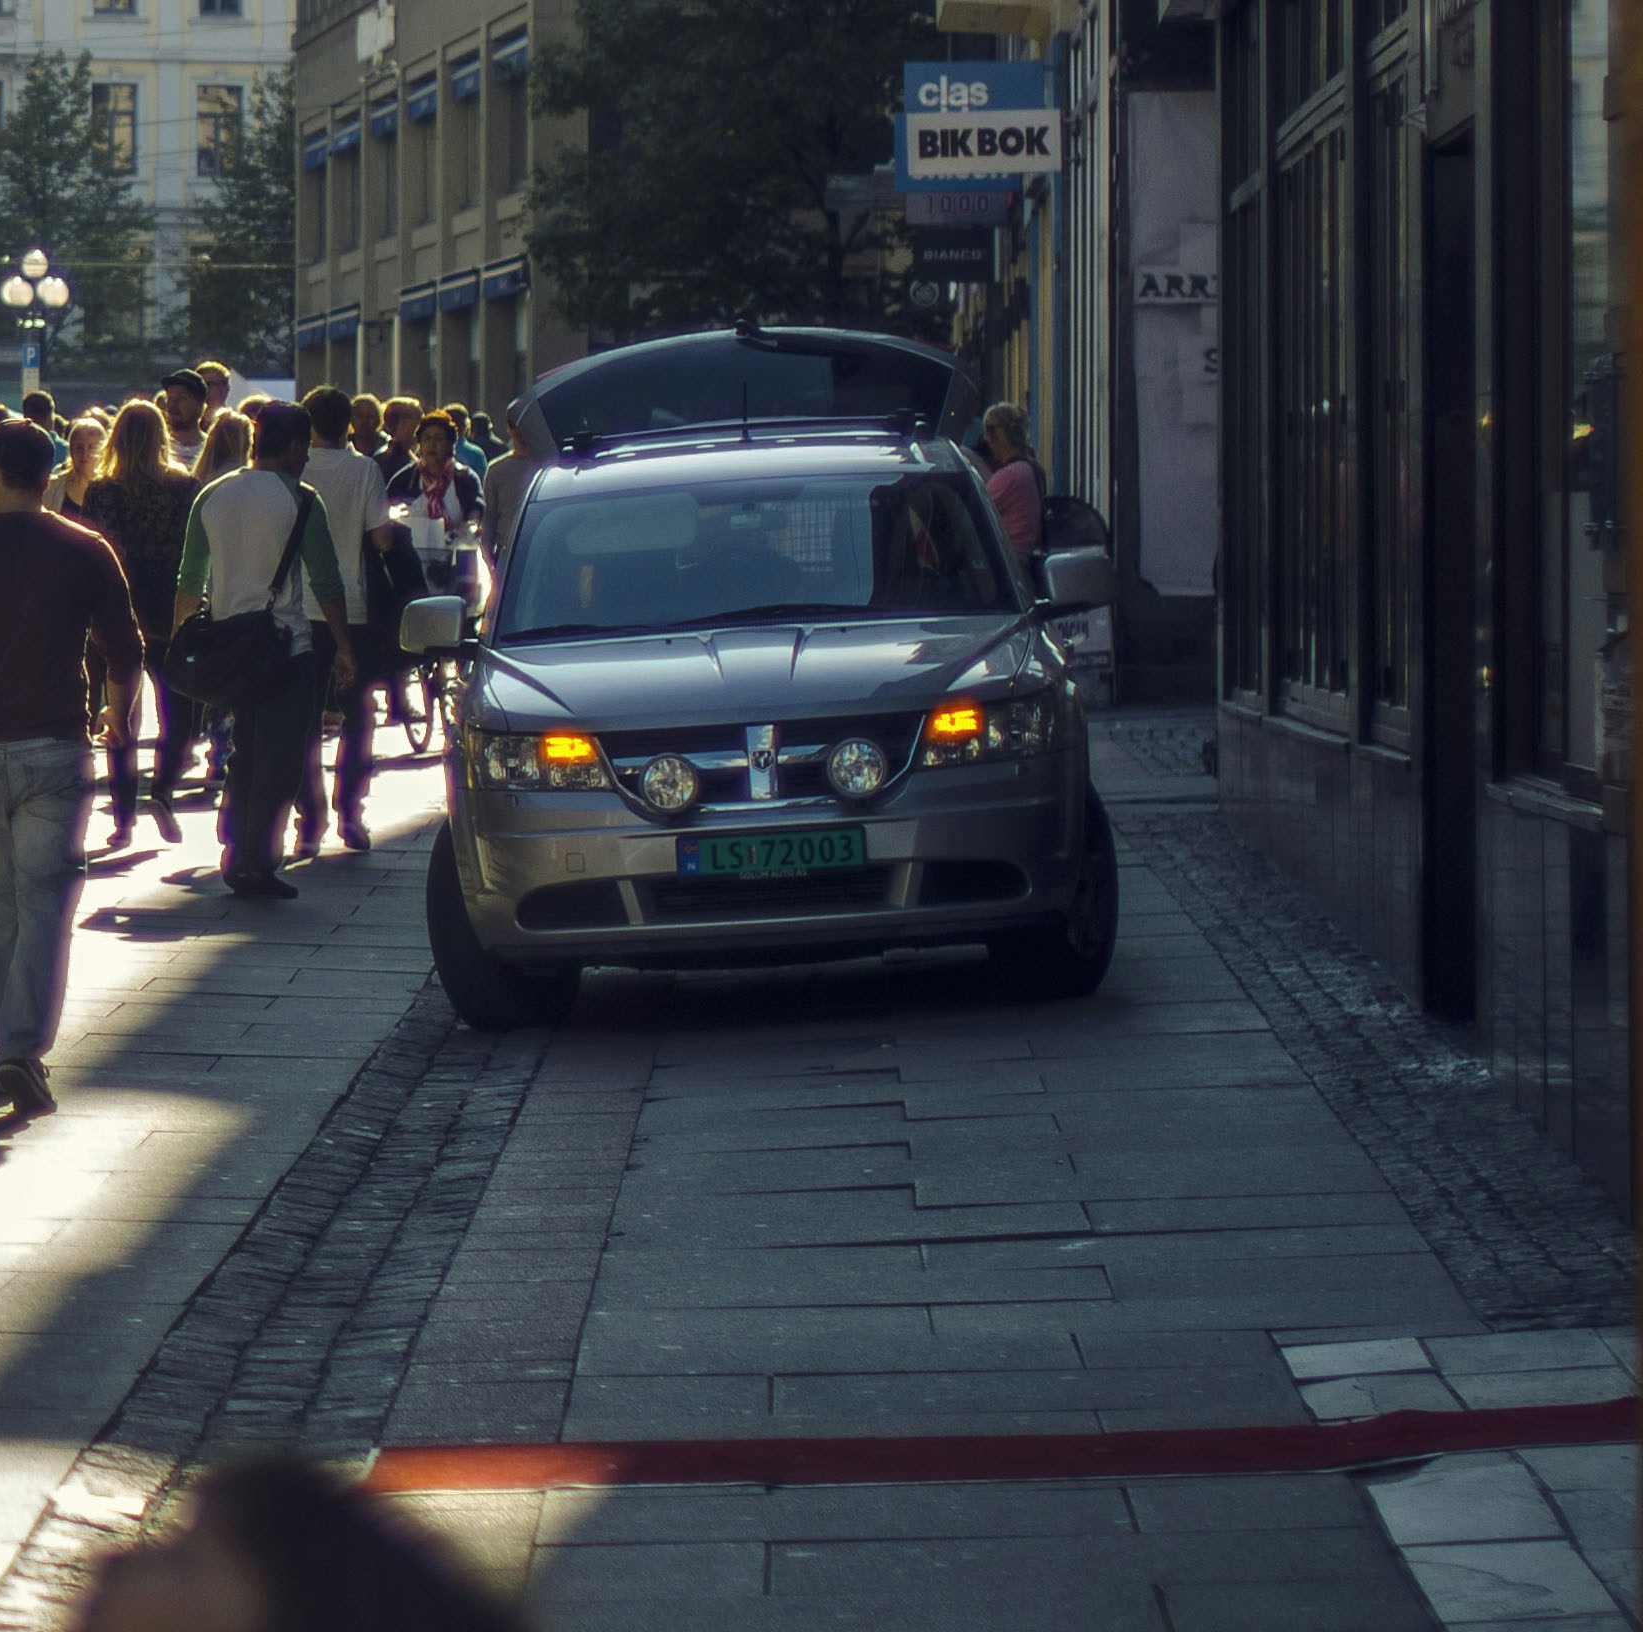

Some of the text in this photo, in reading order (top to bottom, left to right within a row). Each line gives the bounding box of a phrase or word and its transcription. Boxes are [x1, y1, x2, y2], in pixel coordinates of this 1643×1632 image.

[917, 74, 989, 107] clas
[918, 125, 1051, 159] BIK BOK
[923, 247, 983, 262] BIANCO
[26, 346, 37, 367] P
[711, 841, 744, 870] LS
[760, 834, 855, 867] 72003
[771, 869, 795, 878] AUTO
